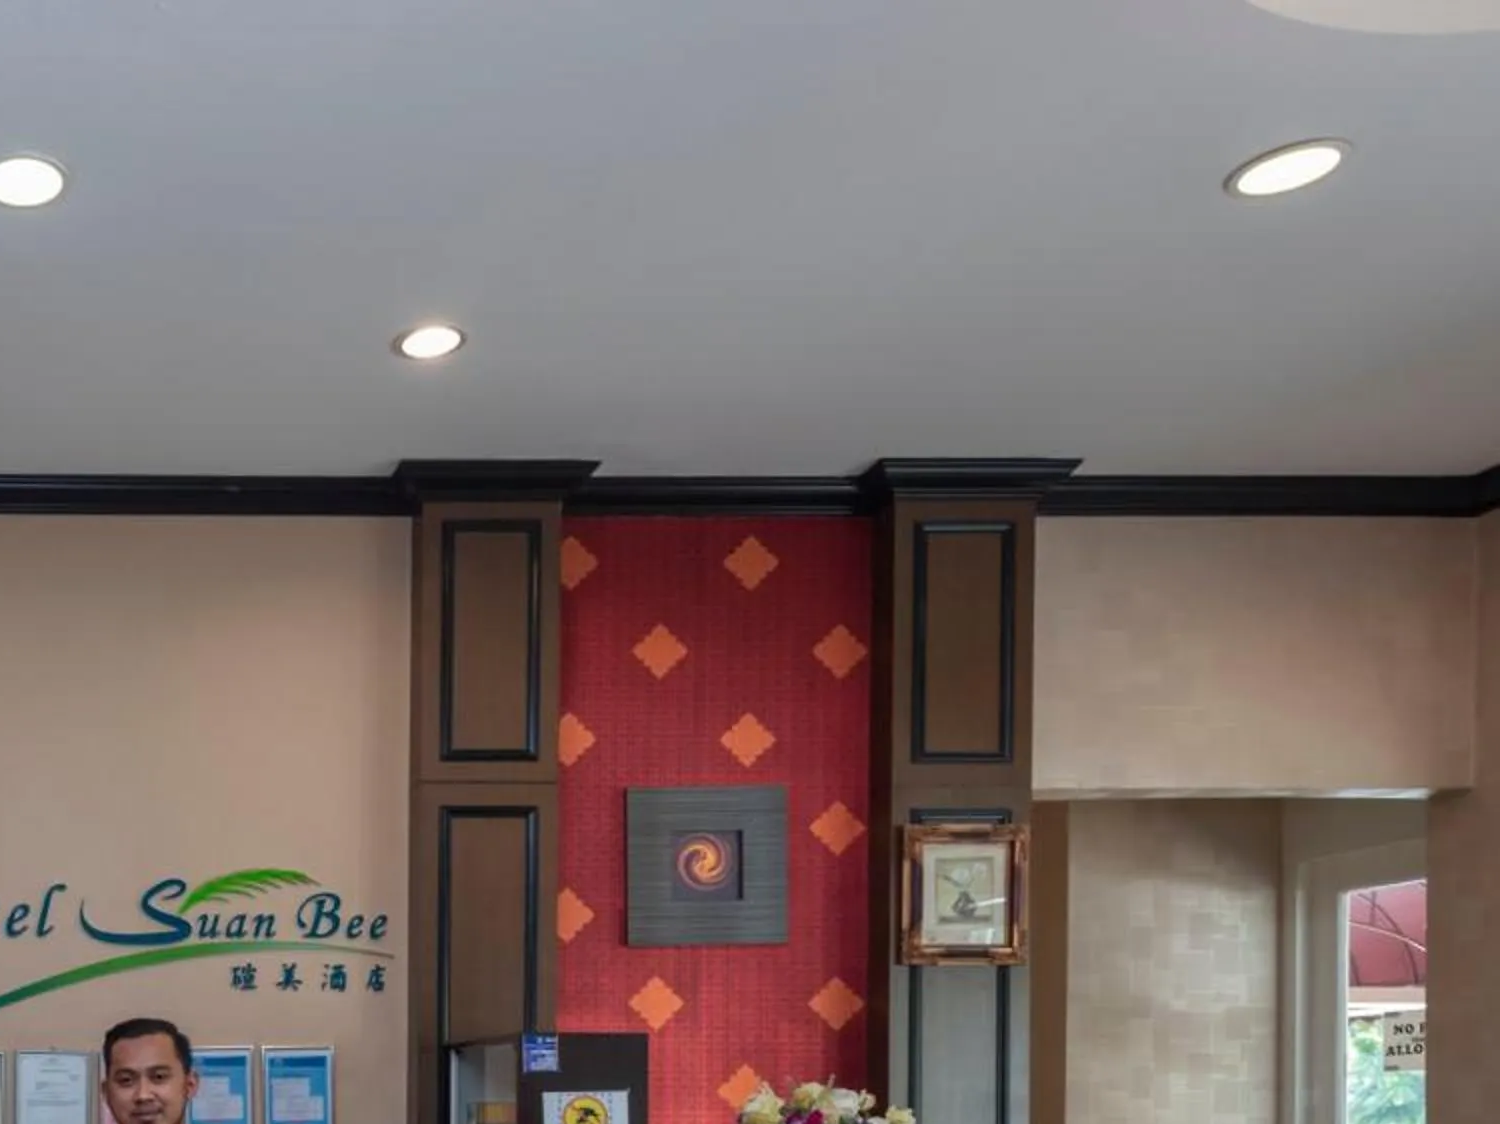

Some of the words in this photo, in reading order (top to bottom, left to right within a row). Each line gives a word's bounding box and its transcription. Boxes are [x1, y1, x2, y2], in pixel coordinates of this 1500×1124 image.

[79, 878, 277, 946] Suan
[296, 892, 389, 940] Bee
[1393, 1022, 1415, 1036] NO
